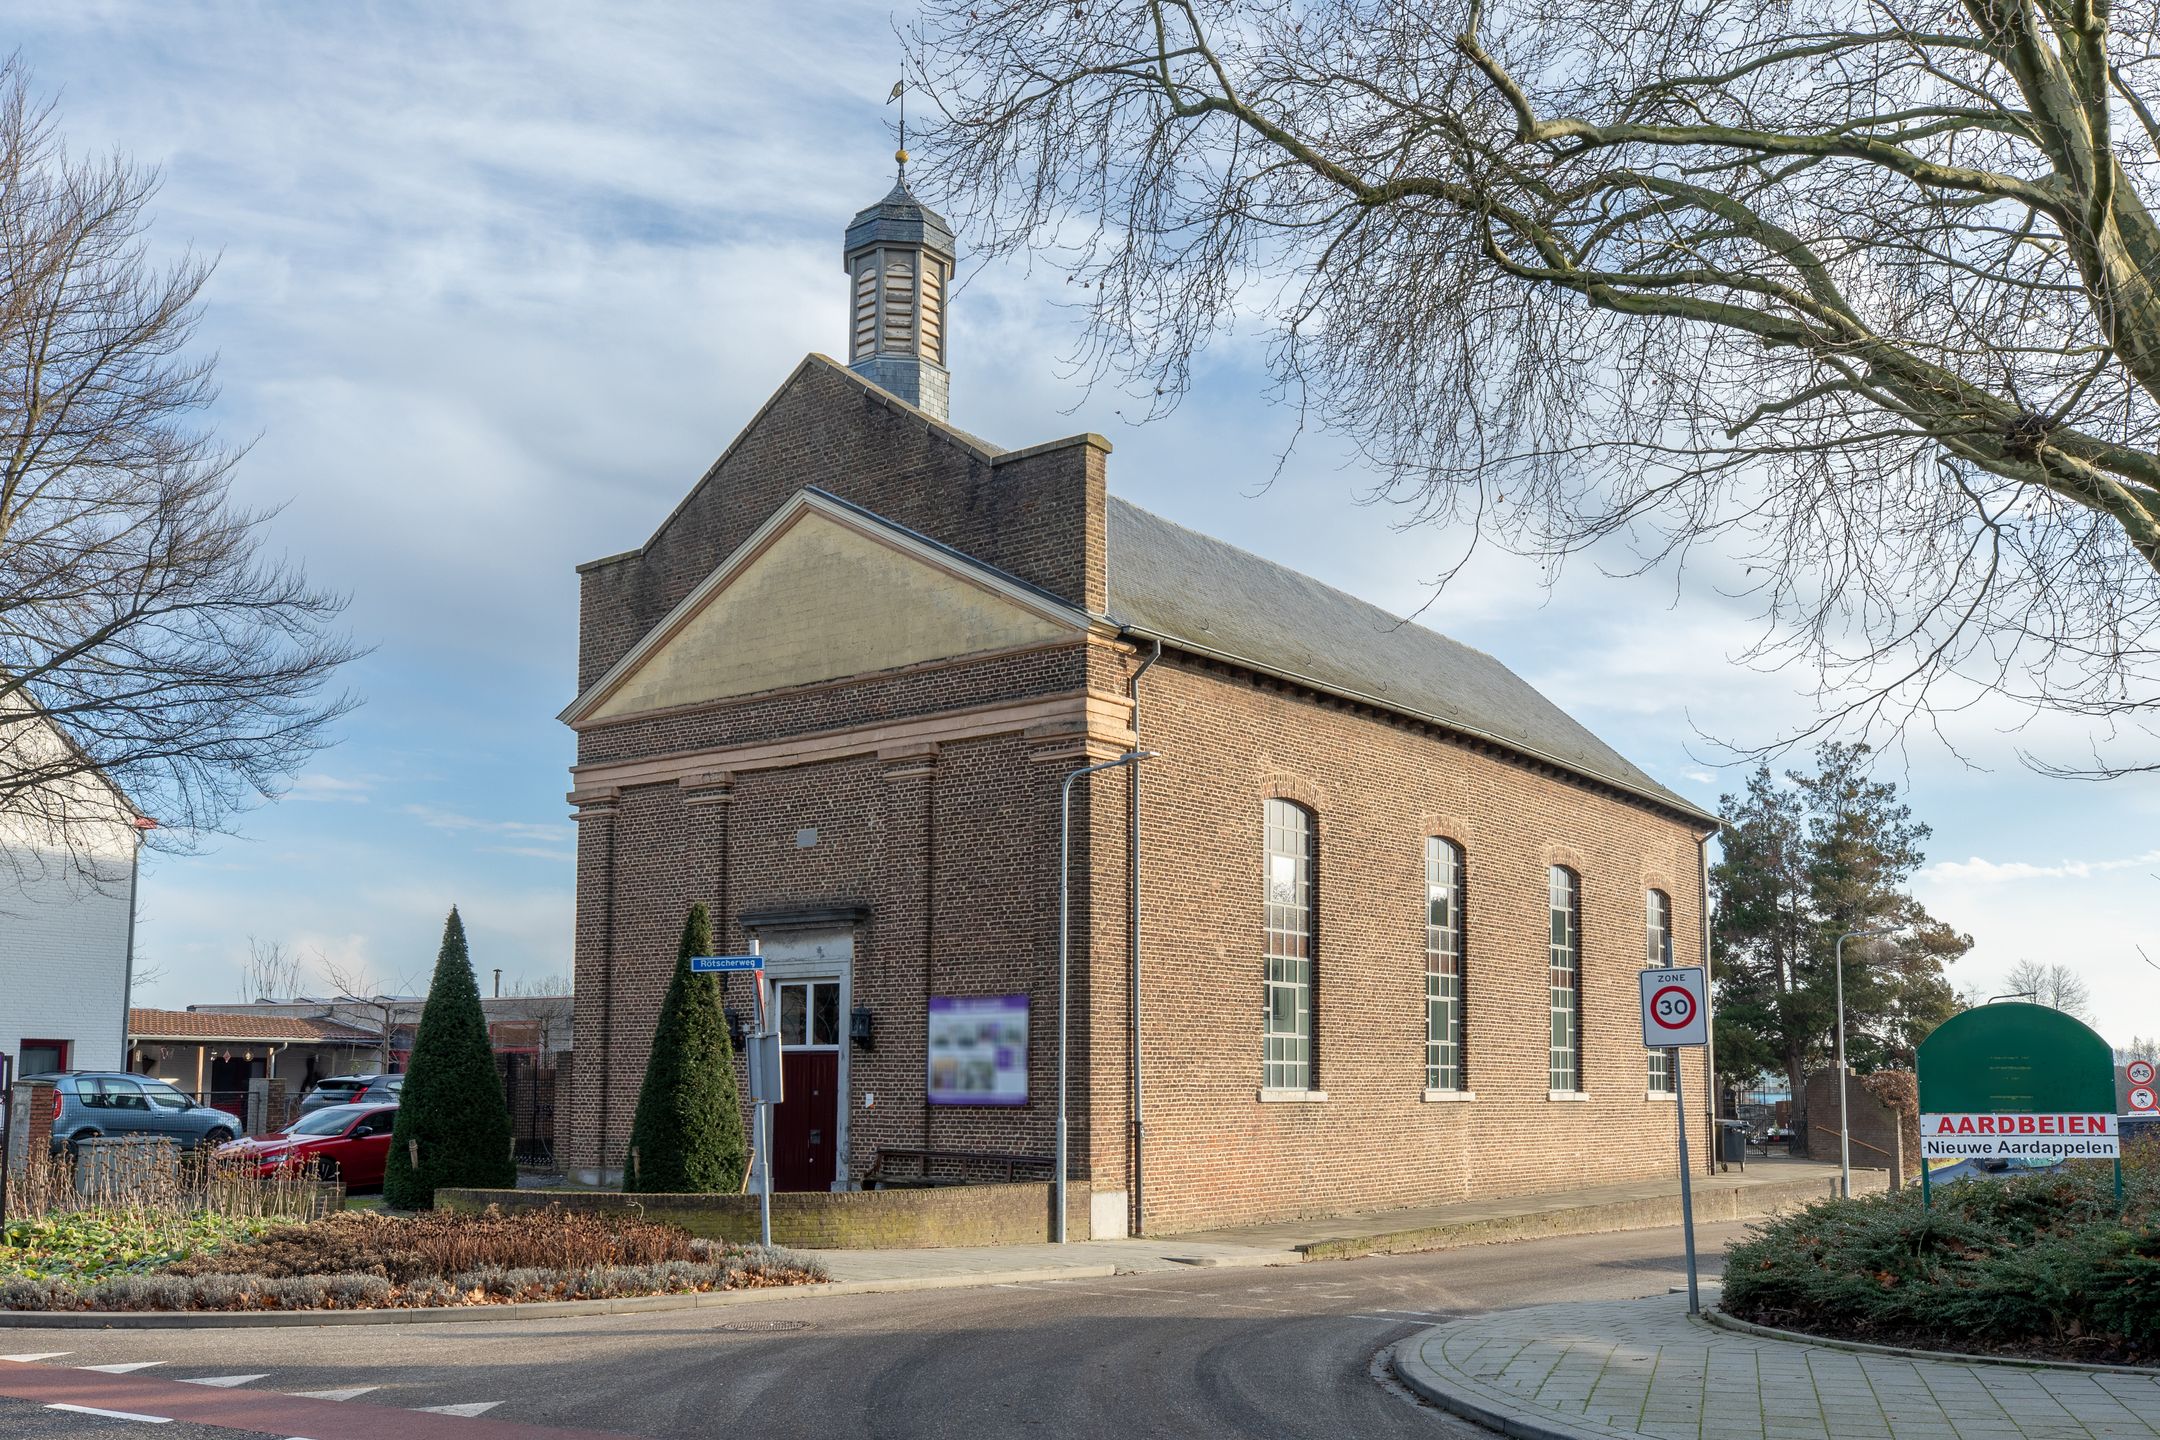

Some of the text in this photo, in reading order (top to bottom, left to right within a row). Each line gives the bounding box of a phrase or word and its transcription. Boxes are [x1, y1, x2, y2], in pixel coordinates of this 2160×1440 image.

[700, 959, 756, 968] Rötscherweg
[1657, 974, 1686, 983] ZONE
[1660, 1000, 1688, 1015] 30
[1937, 1116, 2107, 1134] AARDBEIEN
[1927, 1140, 2114, 1157] Nieuwe Aardappelen
